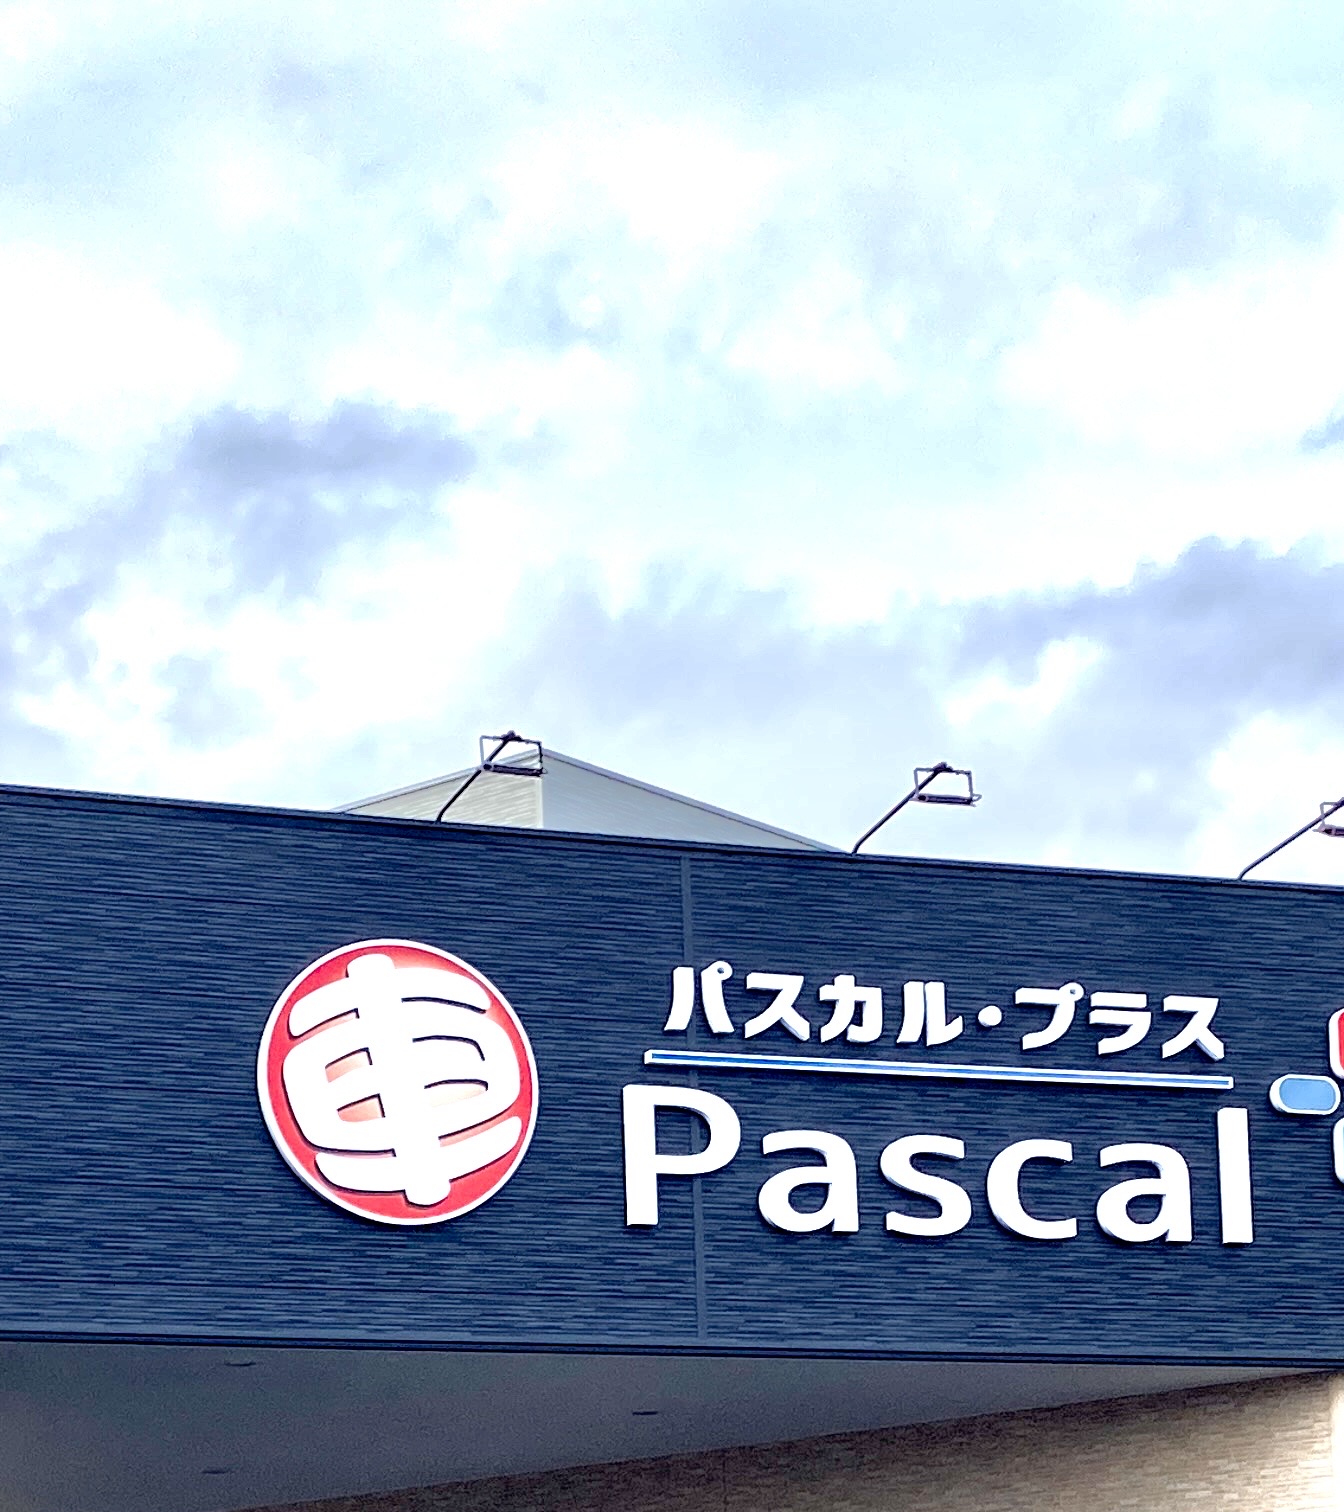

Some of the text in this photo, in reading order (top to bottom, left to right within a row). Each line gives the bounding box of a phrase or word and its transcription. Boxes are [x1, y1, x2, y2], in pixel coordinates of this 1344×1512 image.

[663, 960, 1226, 1061] パスカル・プラス
[622, 1083, 1254, 1244] Pascal
